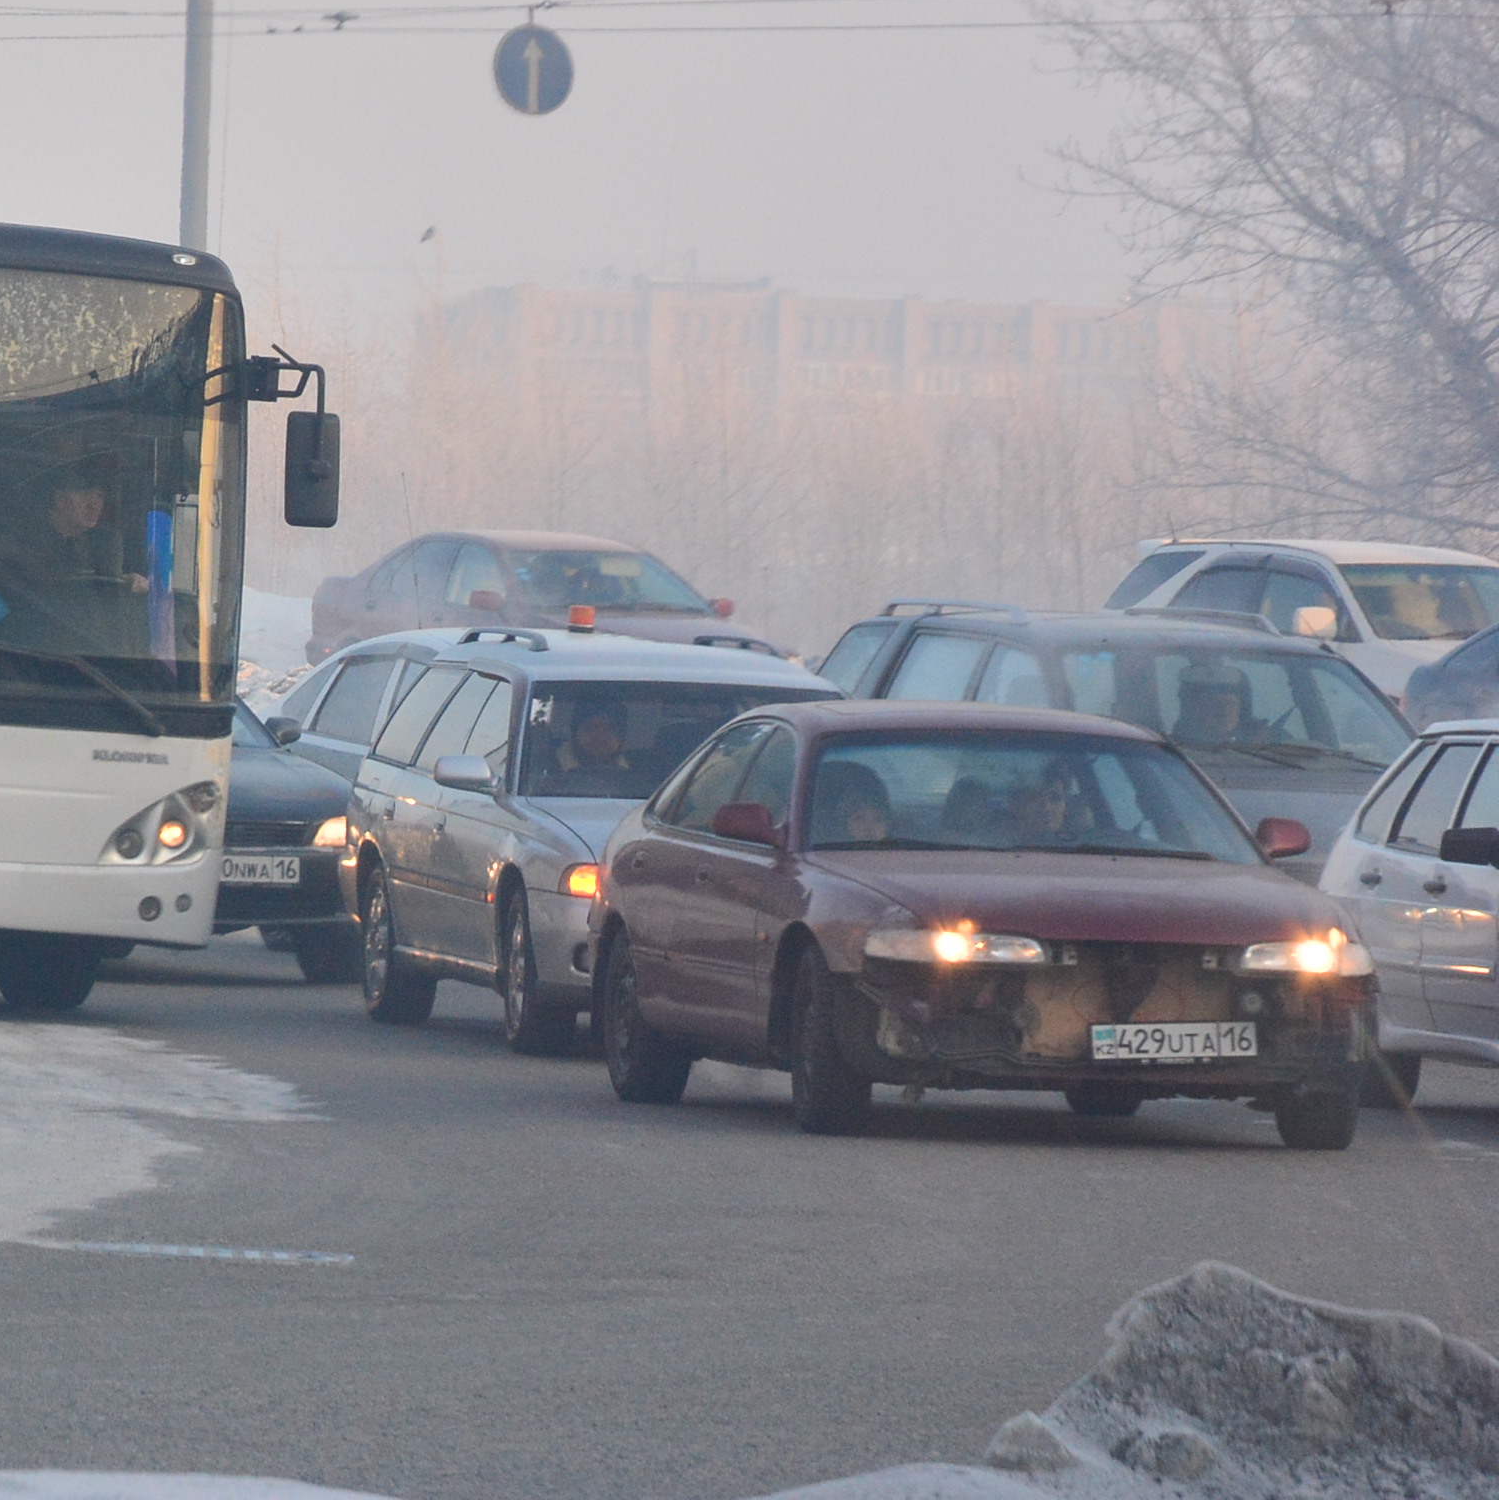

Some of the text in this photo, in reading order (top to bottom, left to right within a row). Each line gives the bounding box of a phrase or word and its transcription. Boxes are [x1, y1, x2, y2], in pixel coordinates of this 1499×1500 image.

[275, 858, 297, 880] 16
[1095, 1044, 1115, 1055] KZ
[1118, 1026, 1253, 1055] 429UTA 16
